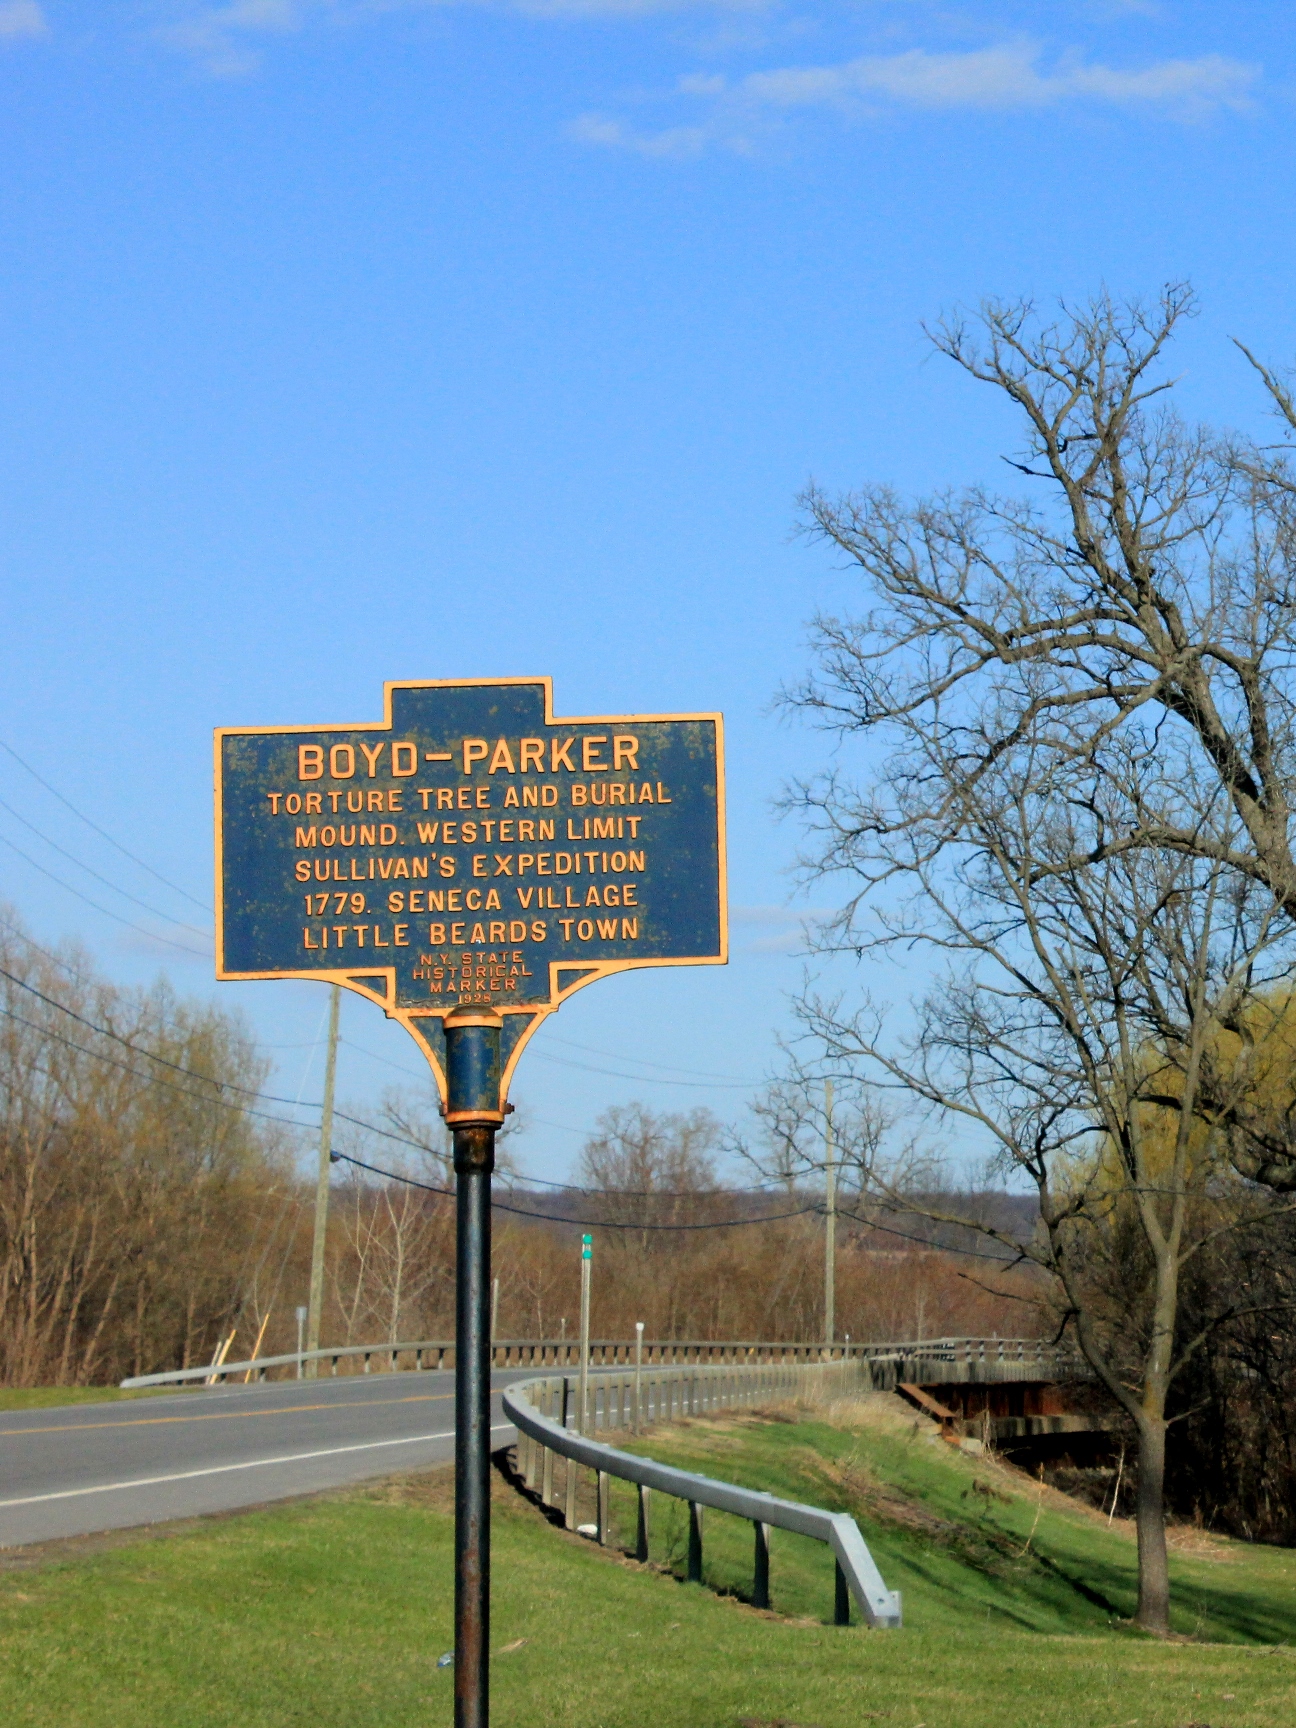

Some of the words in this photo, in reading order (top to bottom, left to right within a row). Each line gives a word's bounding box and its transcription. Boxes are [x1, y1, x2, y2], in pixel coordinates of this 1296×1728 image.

[268, 790, 403, 815] TORTURE
[418, 787, 492, 811] TREE
[504, 785, 559, 808] AND
[571, 782, 672, 806] BURIAL
[295, 823, 406, 848] MOUND.
[416, 819, 555, 845] WESTERN
[567, 816, 641, 840] LIMIT
[295, 852, 456, 882] SULLIVAN'S
[473, 850, 646, 877] EXPEDITION
[305, 893, 371, 916] 1779.
[389, 888, 501, 913] SENECA
[516, 884, 638, 909] VILLAGE
[303, 923, 409, 950] LITTLE
[430, 920, 547, 945] BEARDS
[559, 917, 638, 941] TOWN
[412, 965, 532, 980] HISTORICAL
[420, 953, 452, 966] N.Y.
[462, 950, 523, 965] STATE
[430, 979, 516, 993] MARKER
